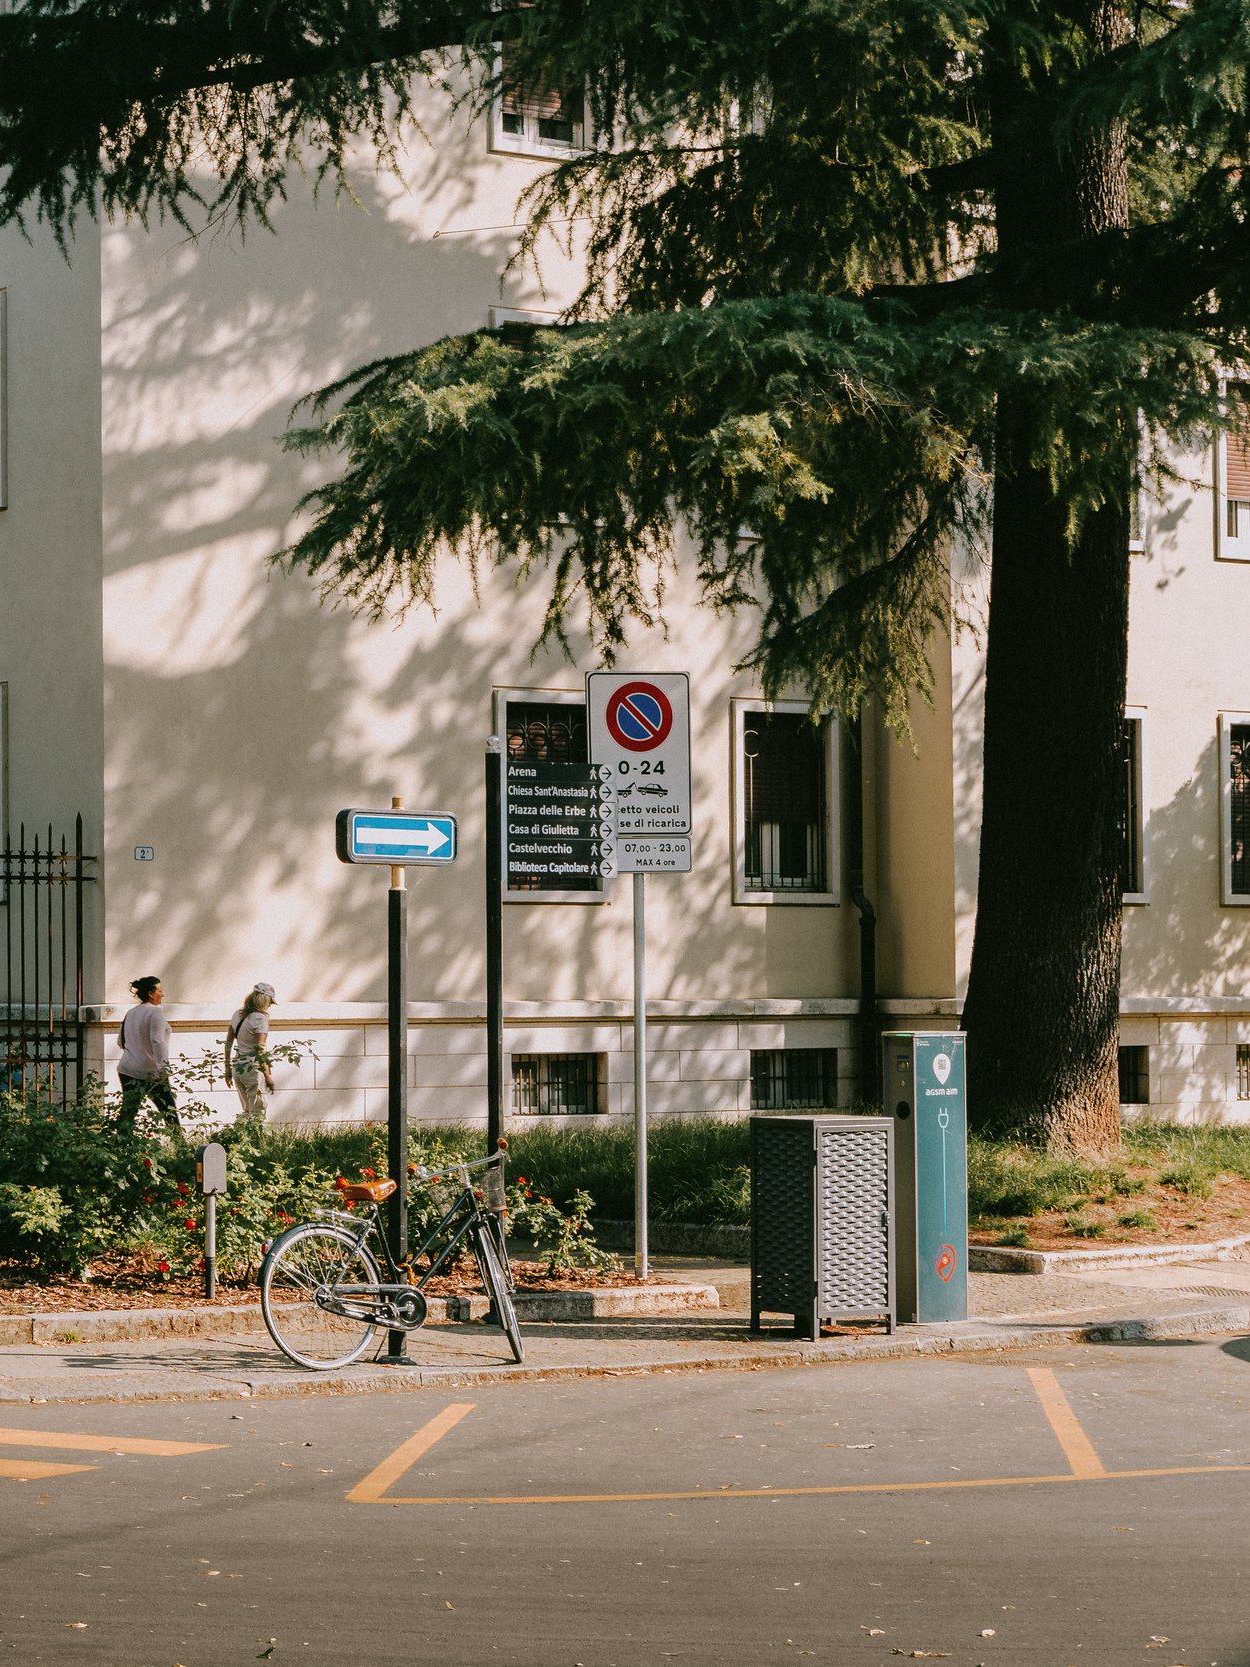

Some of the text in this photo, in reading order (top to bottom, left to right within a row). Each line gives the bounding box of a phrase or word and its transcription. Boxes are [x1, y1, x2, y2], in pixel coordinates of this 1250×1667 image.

[508, 766, 537, 777] Arena
[508, 785, 589, 797] Chiesa Sant'Anastasia
[509, 804, 586, 816] Piazza delle Erbe
[645, 805, 679, 814] veicoli
[634, 819, 644, 828] di
[647, 819, 687, 828] ricarica
[509, 824, 579, 835] Casa di Giulietta
[509, 843, 573, 854] Castelvecchio
[509, 862, 589, 874] Biblioteca Capitolare
